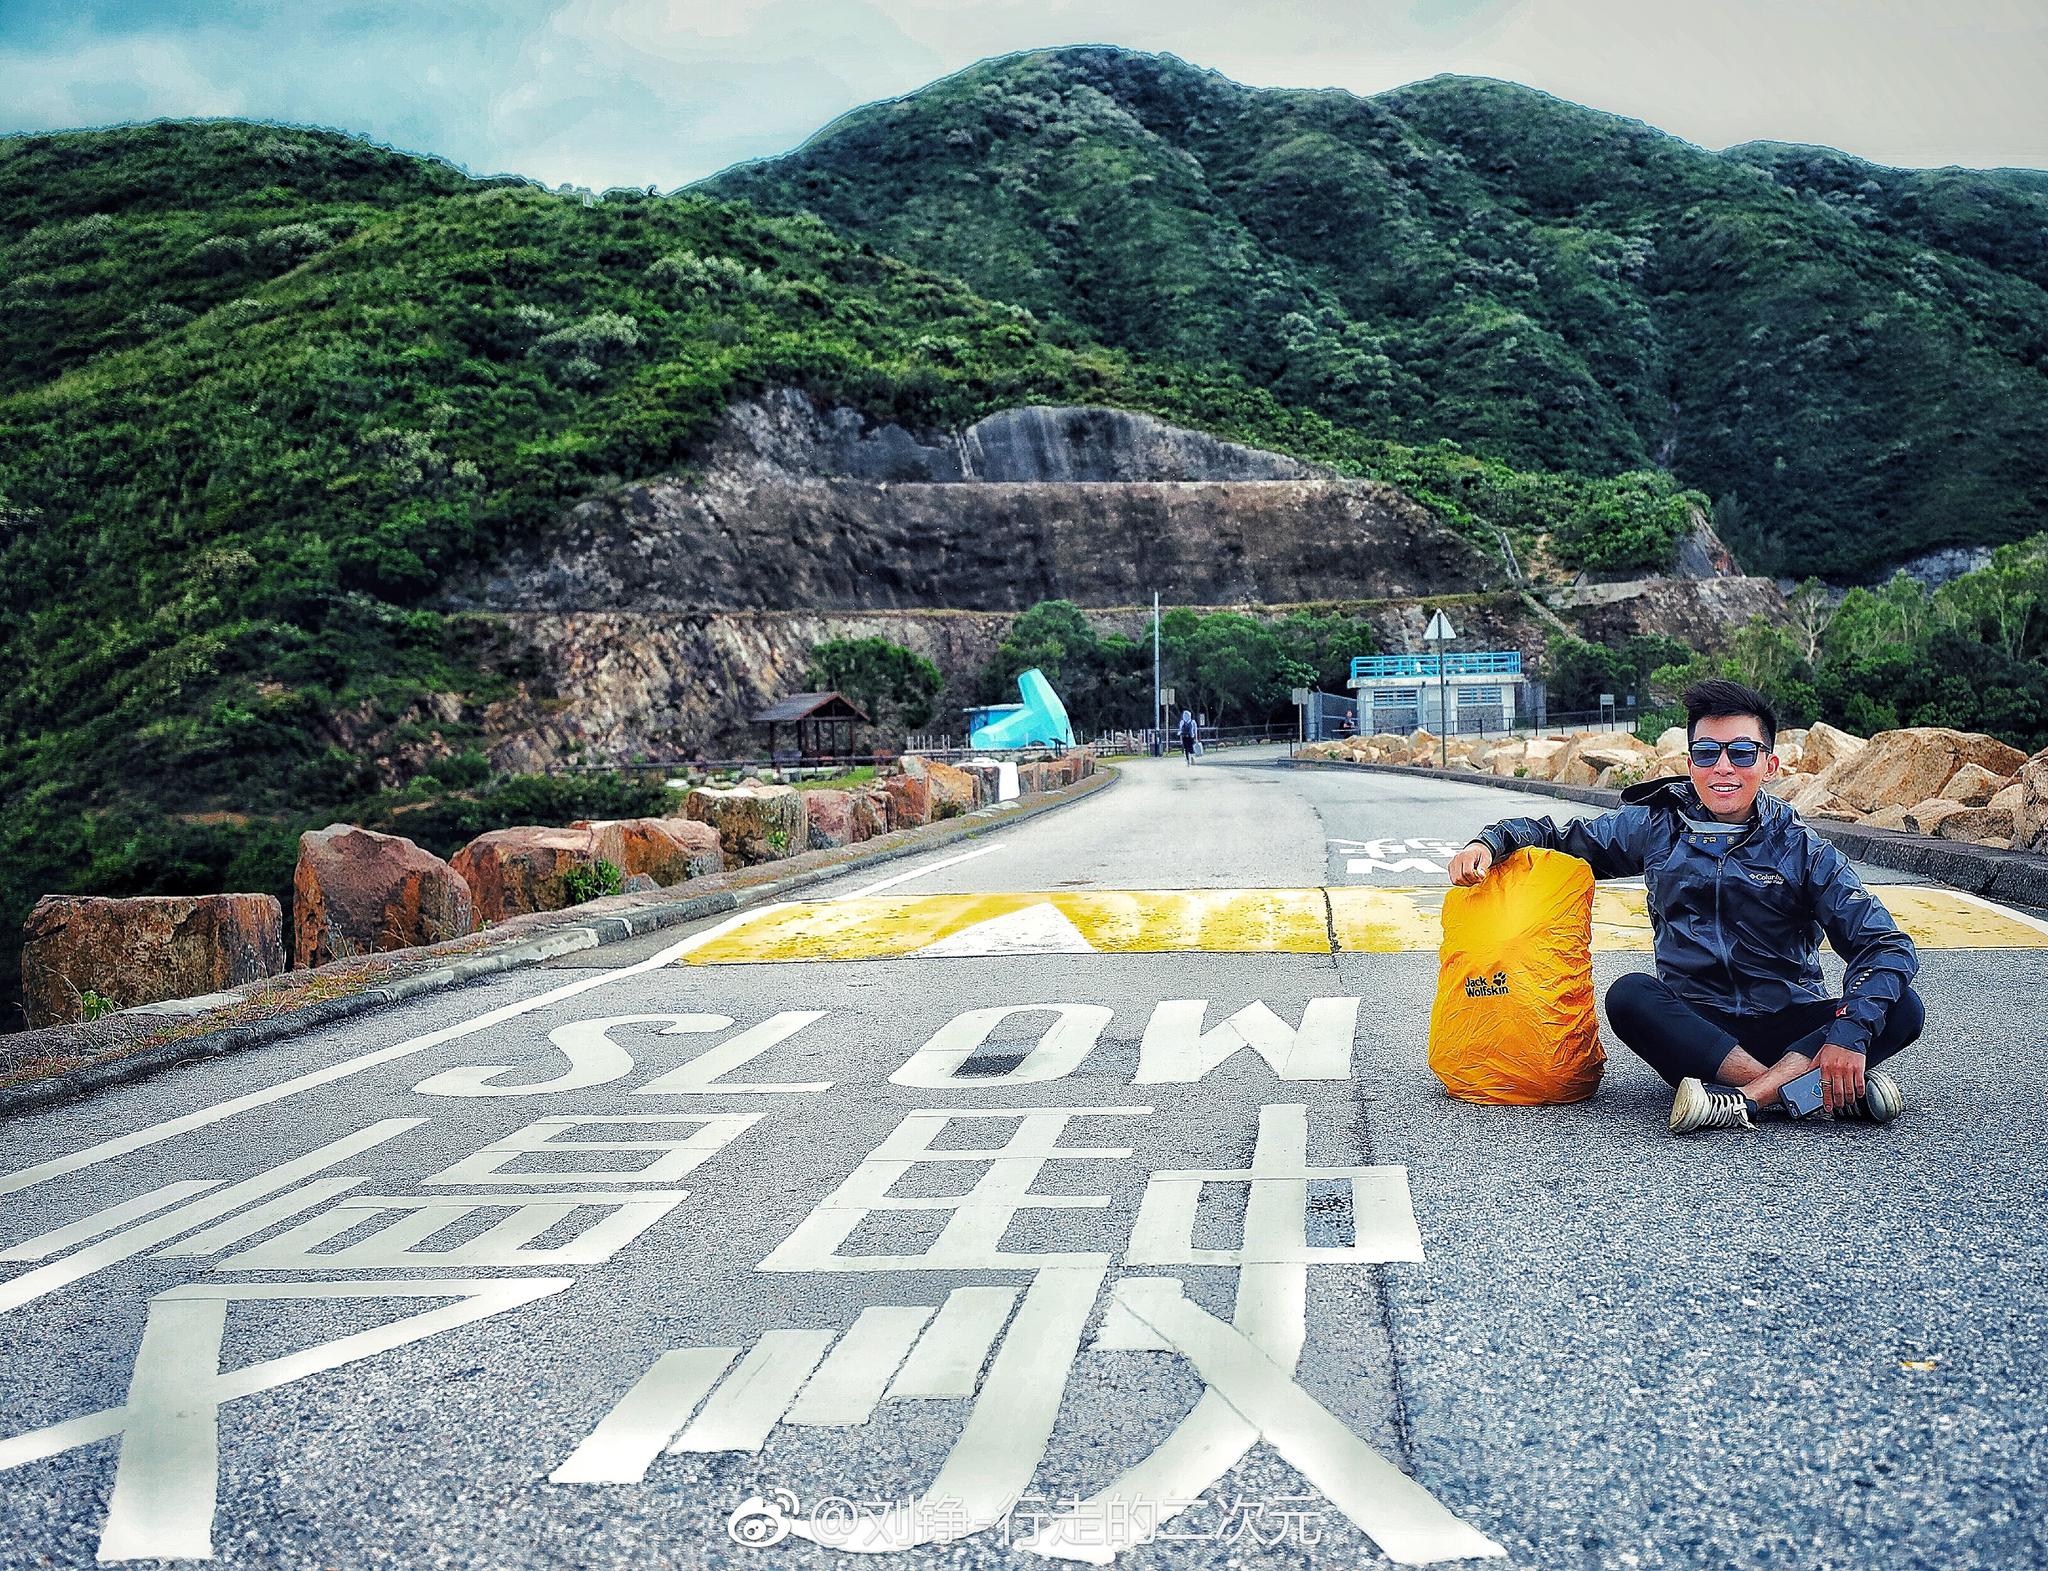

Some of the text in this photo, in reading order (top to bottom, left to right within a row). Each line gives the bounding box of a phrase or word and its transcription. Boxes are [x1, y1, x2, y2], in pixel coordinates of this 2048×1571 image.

[1465, 975, 1488, 987] Jack
[1465, 986, 1509, 997] Wolfskin
[412, 996, 1361, 1097] SLOW
